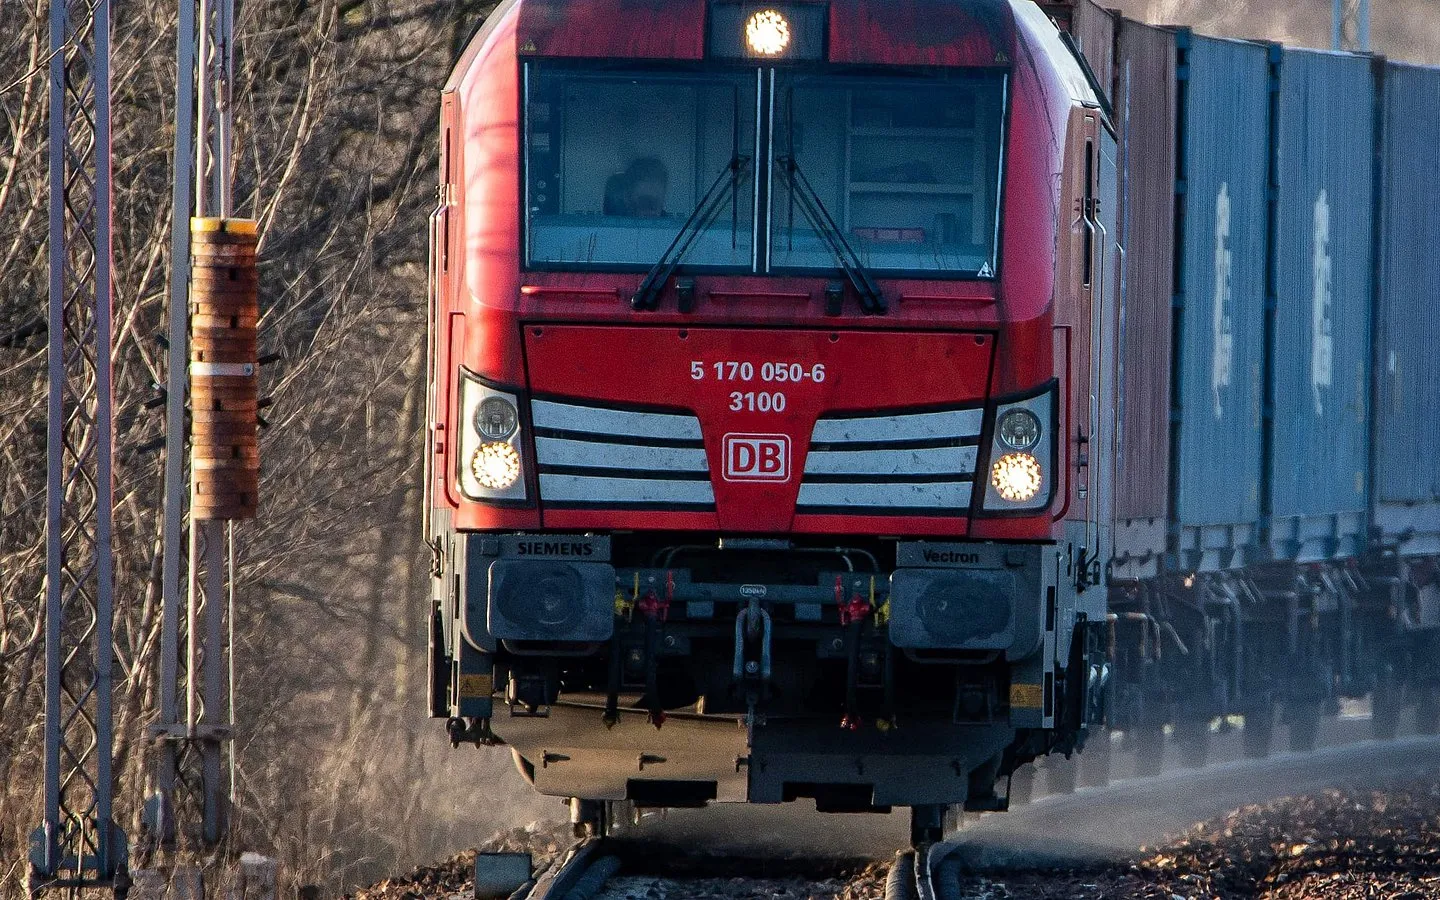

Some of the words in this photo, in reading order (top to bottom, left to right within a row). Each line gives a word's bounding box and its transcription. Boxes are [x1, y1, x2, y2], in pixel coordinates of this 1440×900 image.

[691, 361, 704, 380] 5
[713, 361, 754, 381] 170
[761, 362, 825, 383] 050-6
[728, 391, 786, 412] 3100
[732, 442, 782, 473] DB
[517, 542, 593, 556] SIEMENS
[922, 549, 979, 563] Vectron
